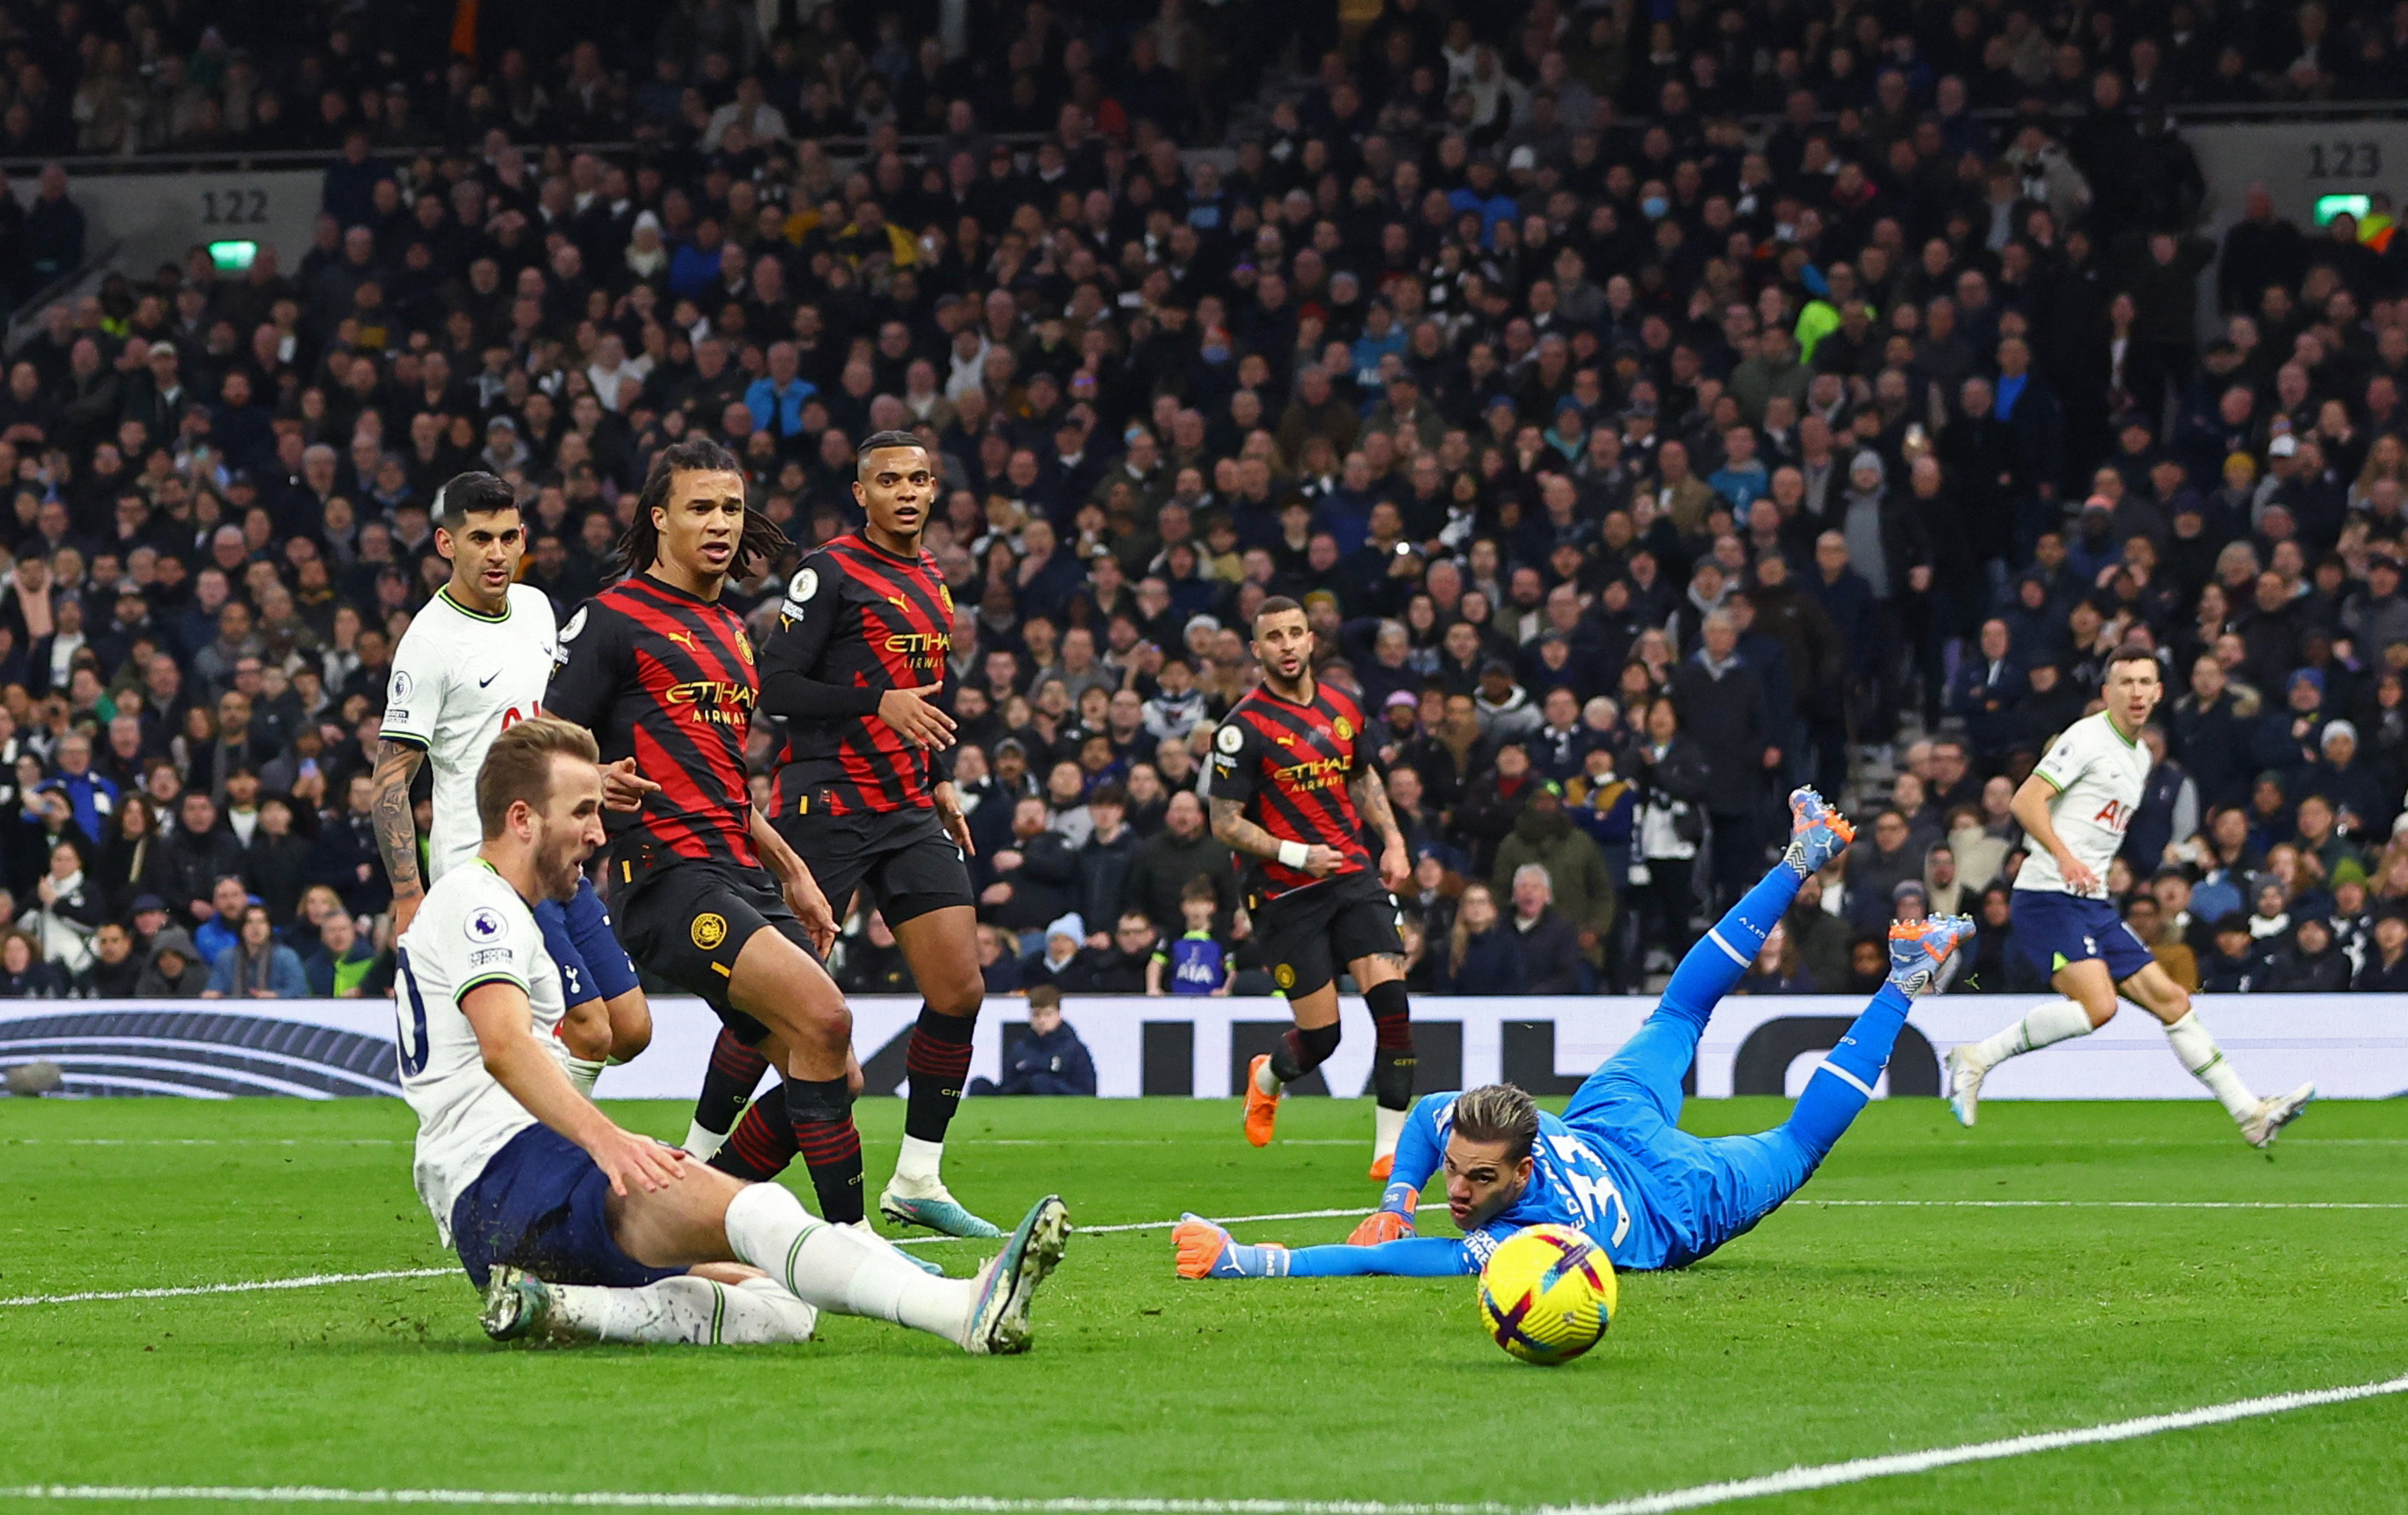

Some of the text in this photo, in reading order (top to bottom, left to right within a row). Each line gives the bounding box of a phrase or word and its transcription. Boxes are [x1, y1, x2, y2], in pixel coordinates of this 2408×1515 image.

[2309, 143, 2380, 178] 123
[202, 189, 268, 225] 122
[885, 632, 952, 653] ETIHA
[1738, 917, 1766, 940] CITY
[941, 1089, 961, 1098] CIT
